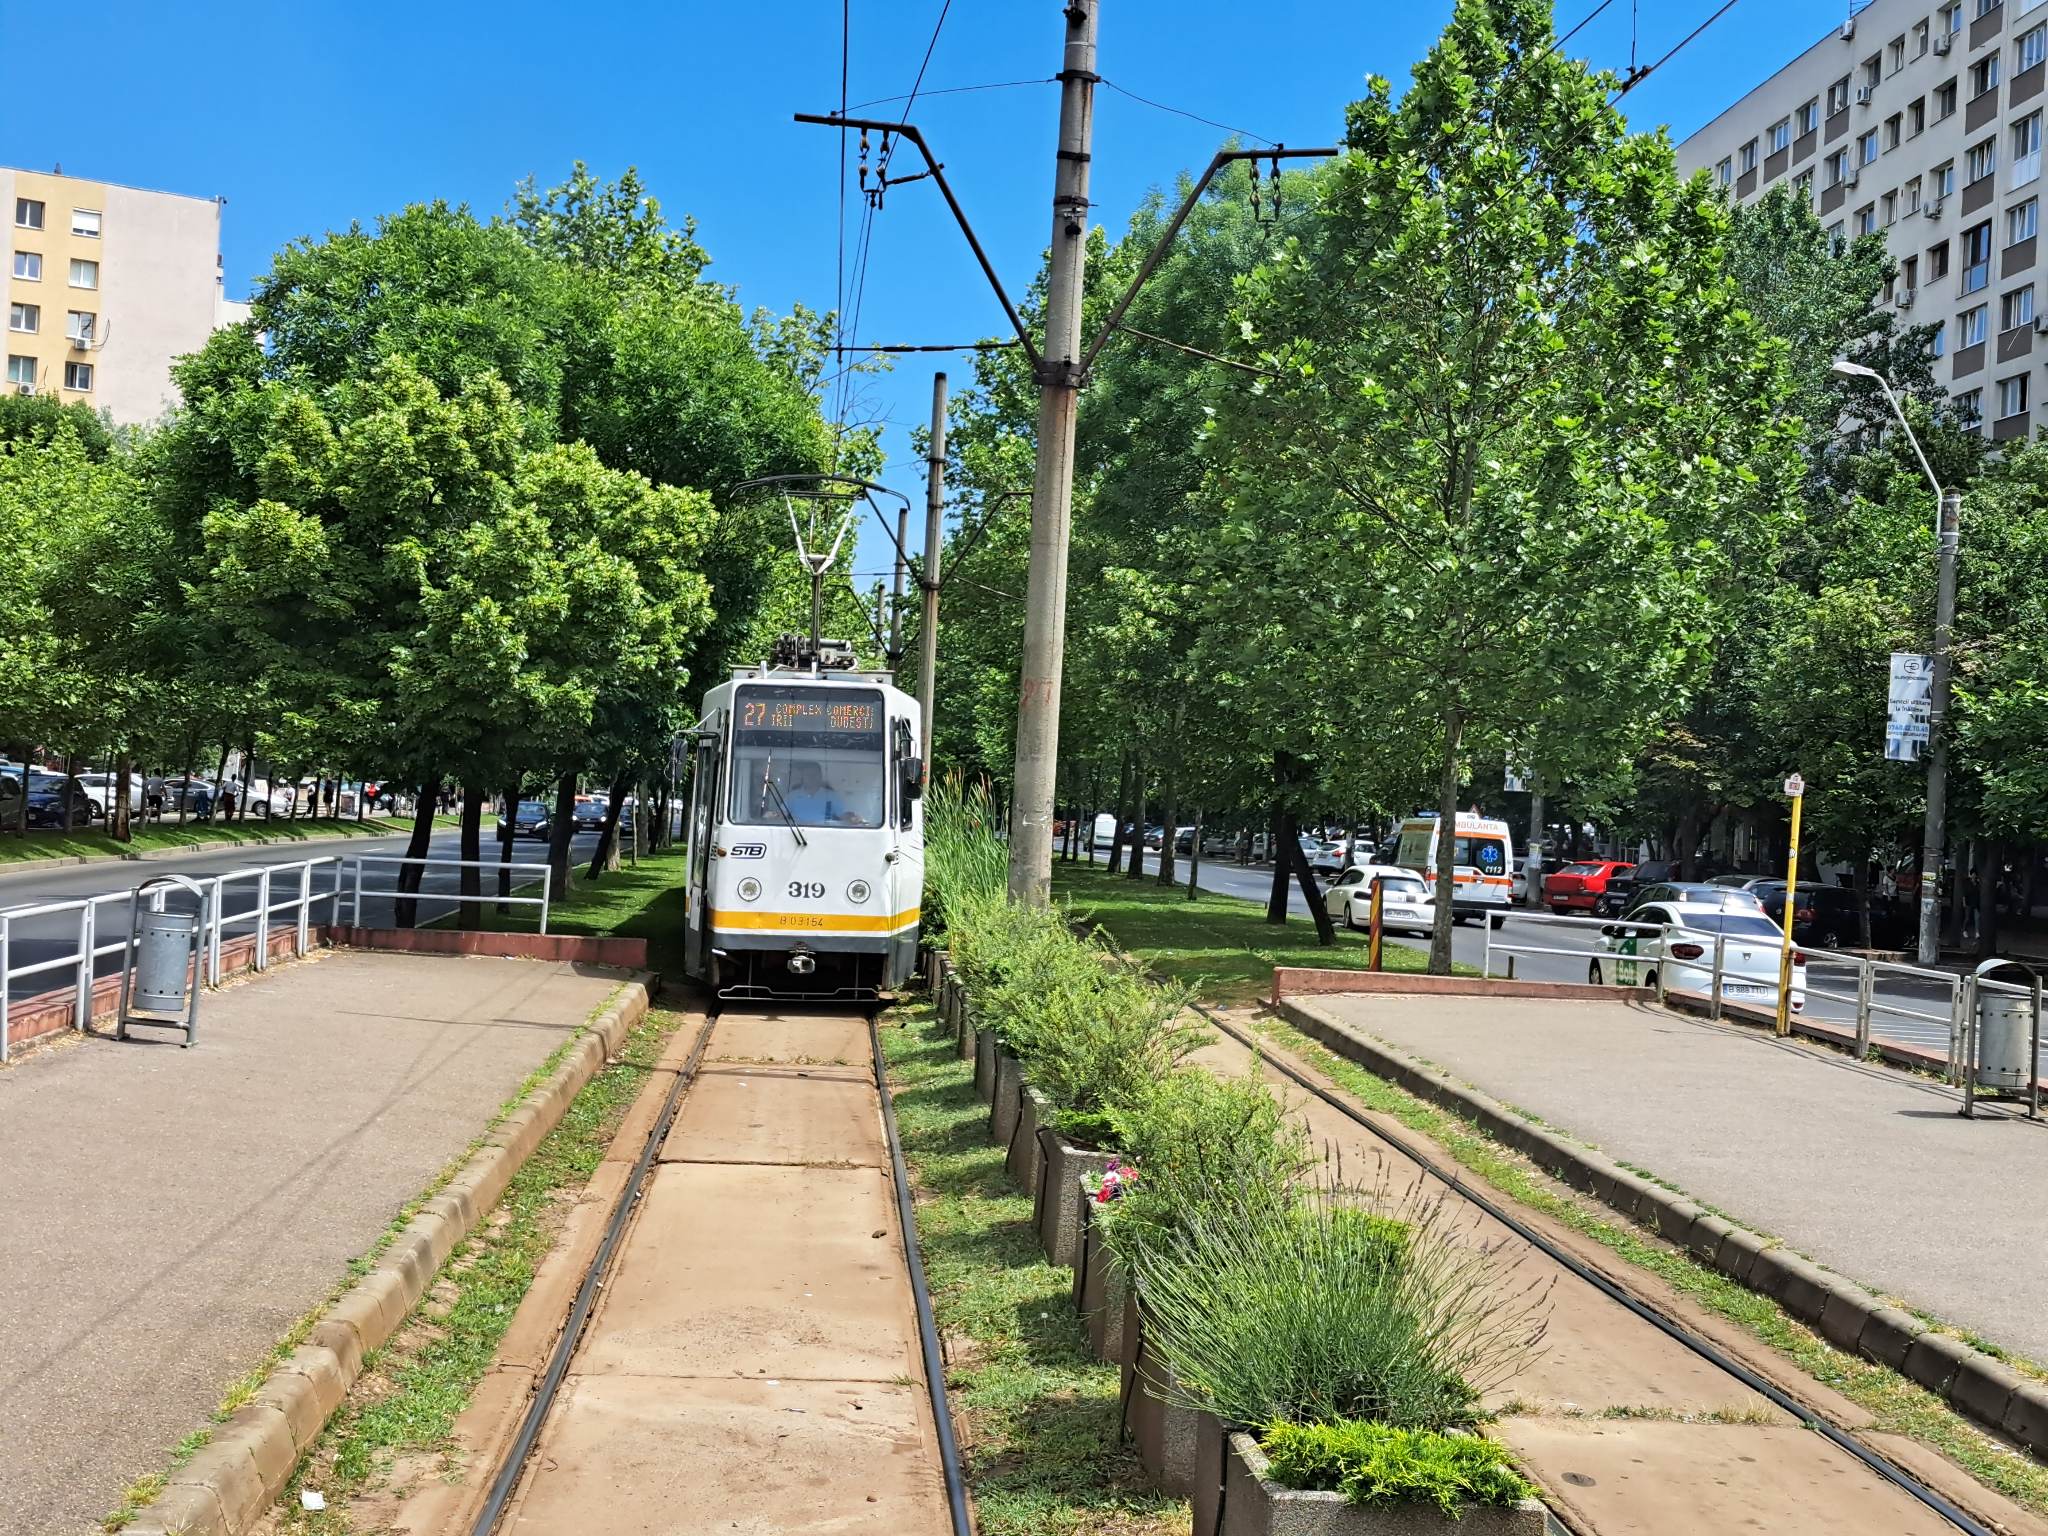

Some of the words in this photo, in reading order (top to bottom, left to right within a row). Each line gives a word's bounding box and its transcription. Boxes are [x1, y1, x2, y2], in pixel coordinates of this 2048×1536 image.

[744, 702, 767, 726] 27
[775, 703, 822, 716] COMPLEX
[1455, 821, 1499, 831] MBULANTA
[730, 844, 764, 858] STB
[788, 881, 826, 899] 319
